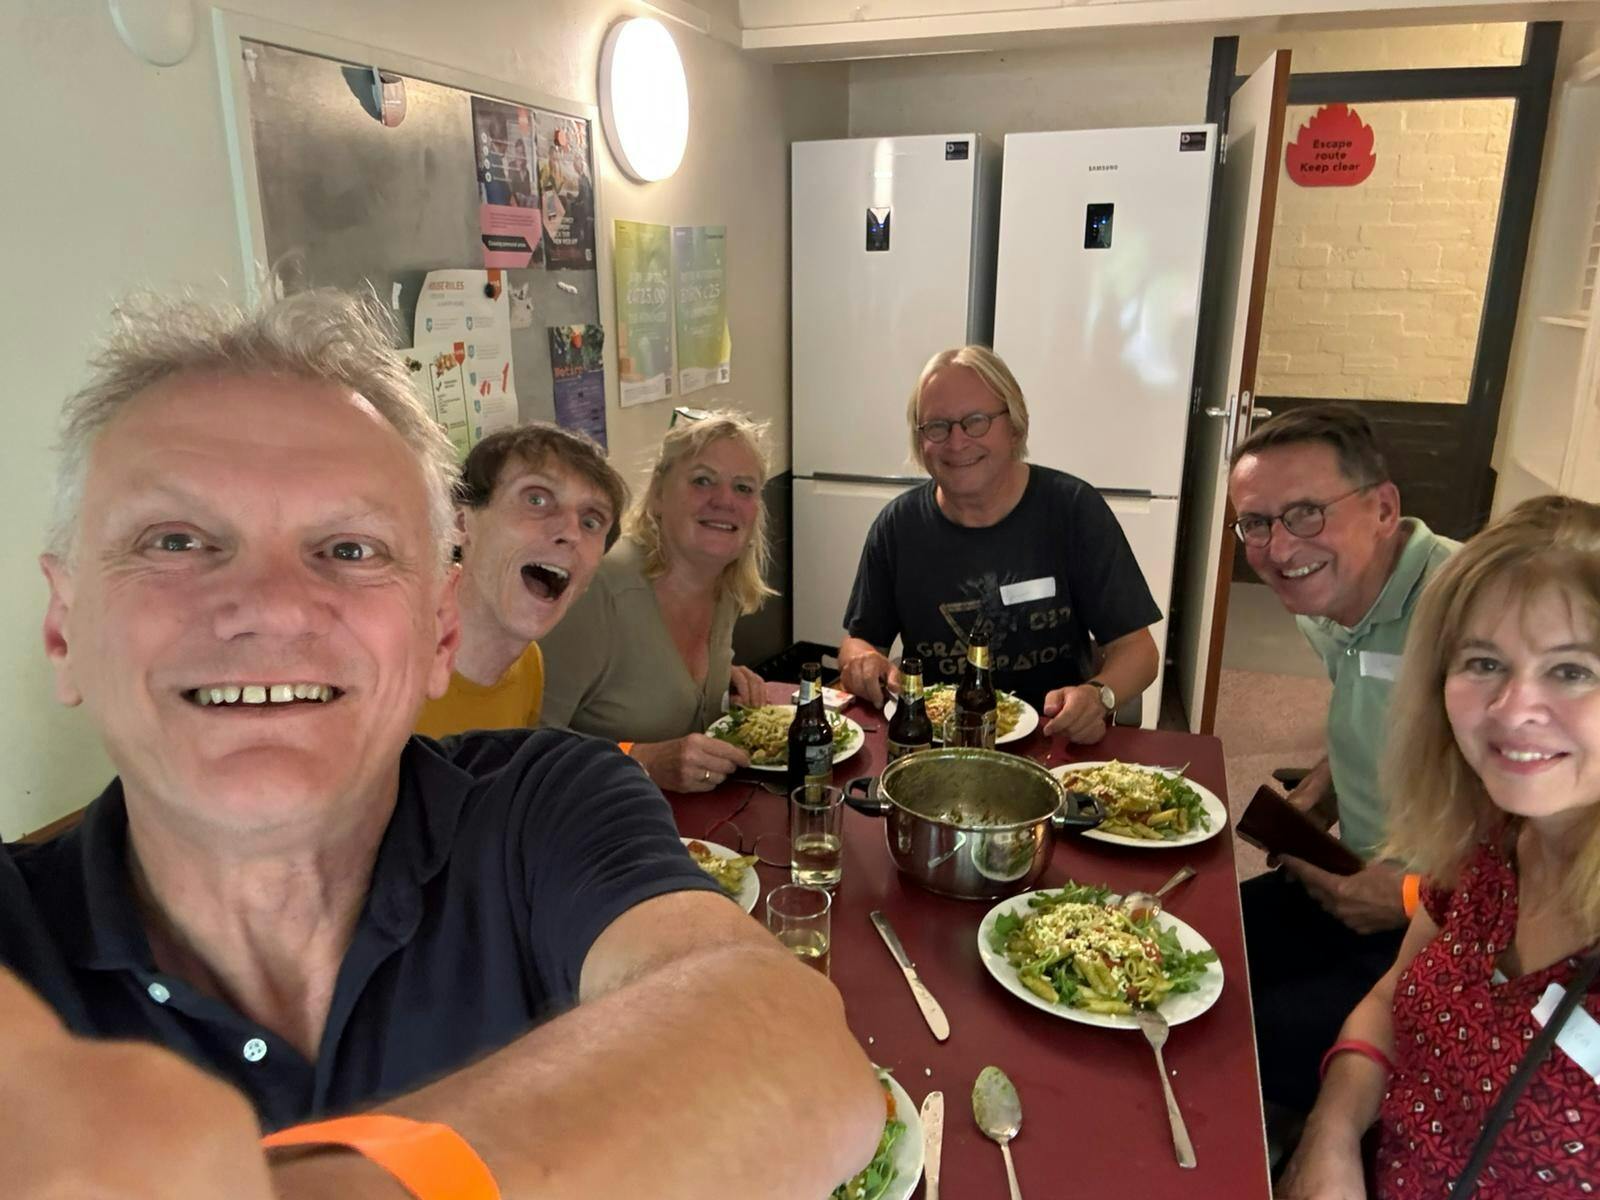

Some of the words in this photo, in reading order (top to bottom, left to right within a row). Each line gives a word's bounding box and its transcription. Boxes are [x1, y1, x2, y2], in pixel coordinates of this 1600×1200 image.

[1312, 139, 1353, 150] Escape
[1315, 151, 1347, 161] route
[1088, 164, 1119, 172] SAMSUNG
[1300, 162, 1330, 174] Keep
[1332, 162, 1361, 172] clear
